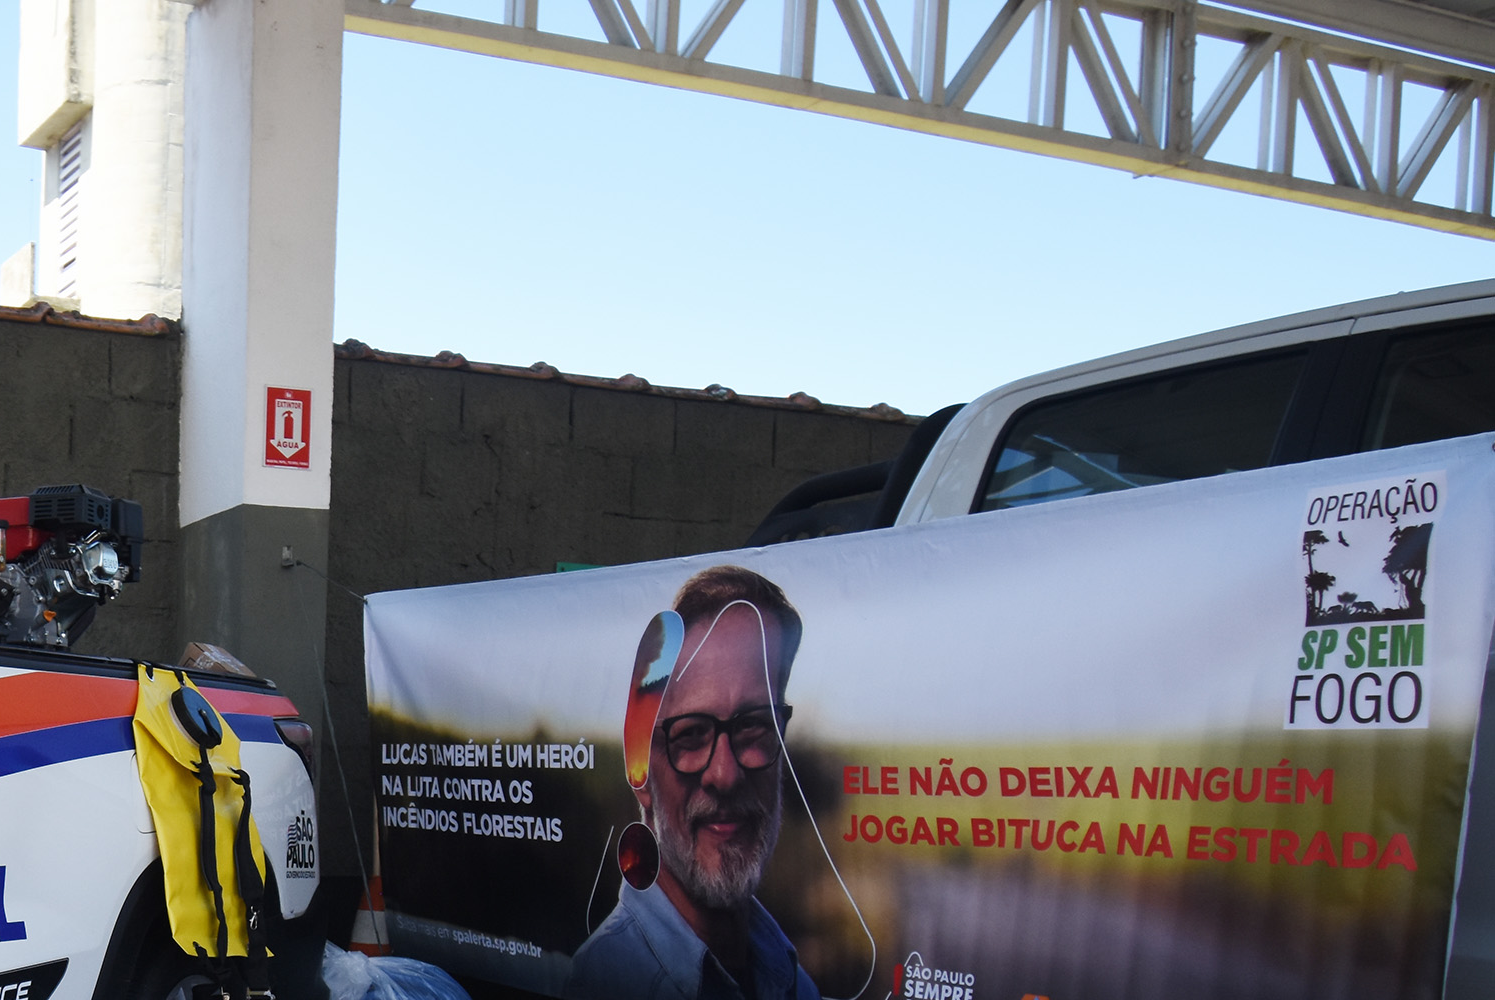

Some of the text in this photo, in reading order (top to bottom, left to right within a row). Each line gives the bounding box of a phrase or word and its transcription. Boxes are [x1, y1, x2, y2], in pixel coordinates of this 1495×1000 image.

[277, 400, 302, 409] EXTINTOR
[1307, 478, 1438, 526] OPERAÇÃO
[1297, 624, 1425, 671] SP SEM
[1289, 670, 1422, 724] FOGO
[382, 737, 594, 769] LUCAS TAMBÉM É UM HERÓI
[382, 775, 534, 804] NA LUTA CONTRA OS
[843, 758, 1335, 805] ELE NÃO DEIXA NINGUÉM
[295, 810, 313, 842] SÃO
[383, 802, 563, 843] INCÊNDIOS FLORESTAIS
[286, 844, 315, 868] PAULO
[843, 814, 1418, 872] JOGAR BITUCA NA ESTRADA
[453, 930, 542, 958] spalerta.sp.gov.br
[906, 964, 975, 986] SÃO PAULO
